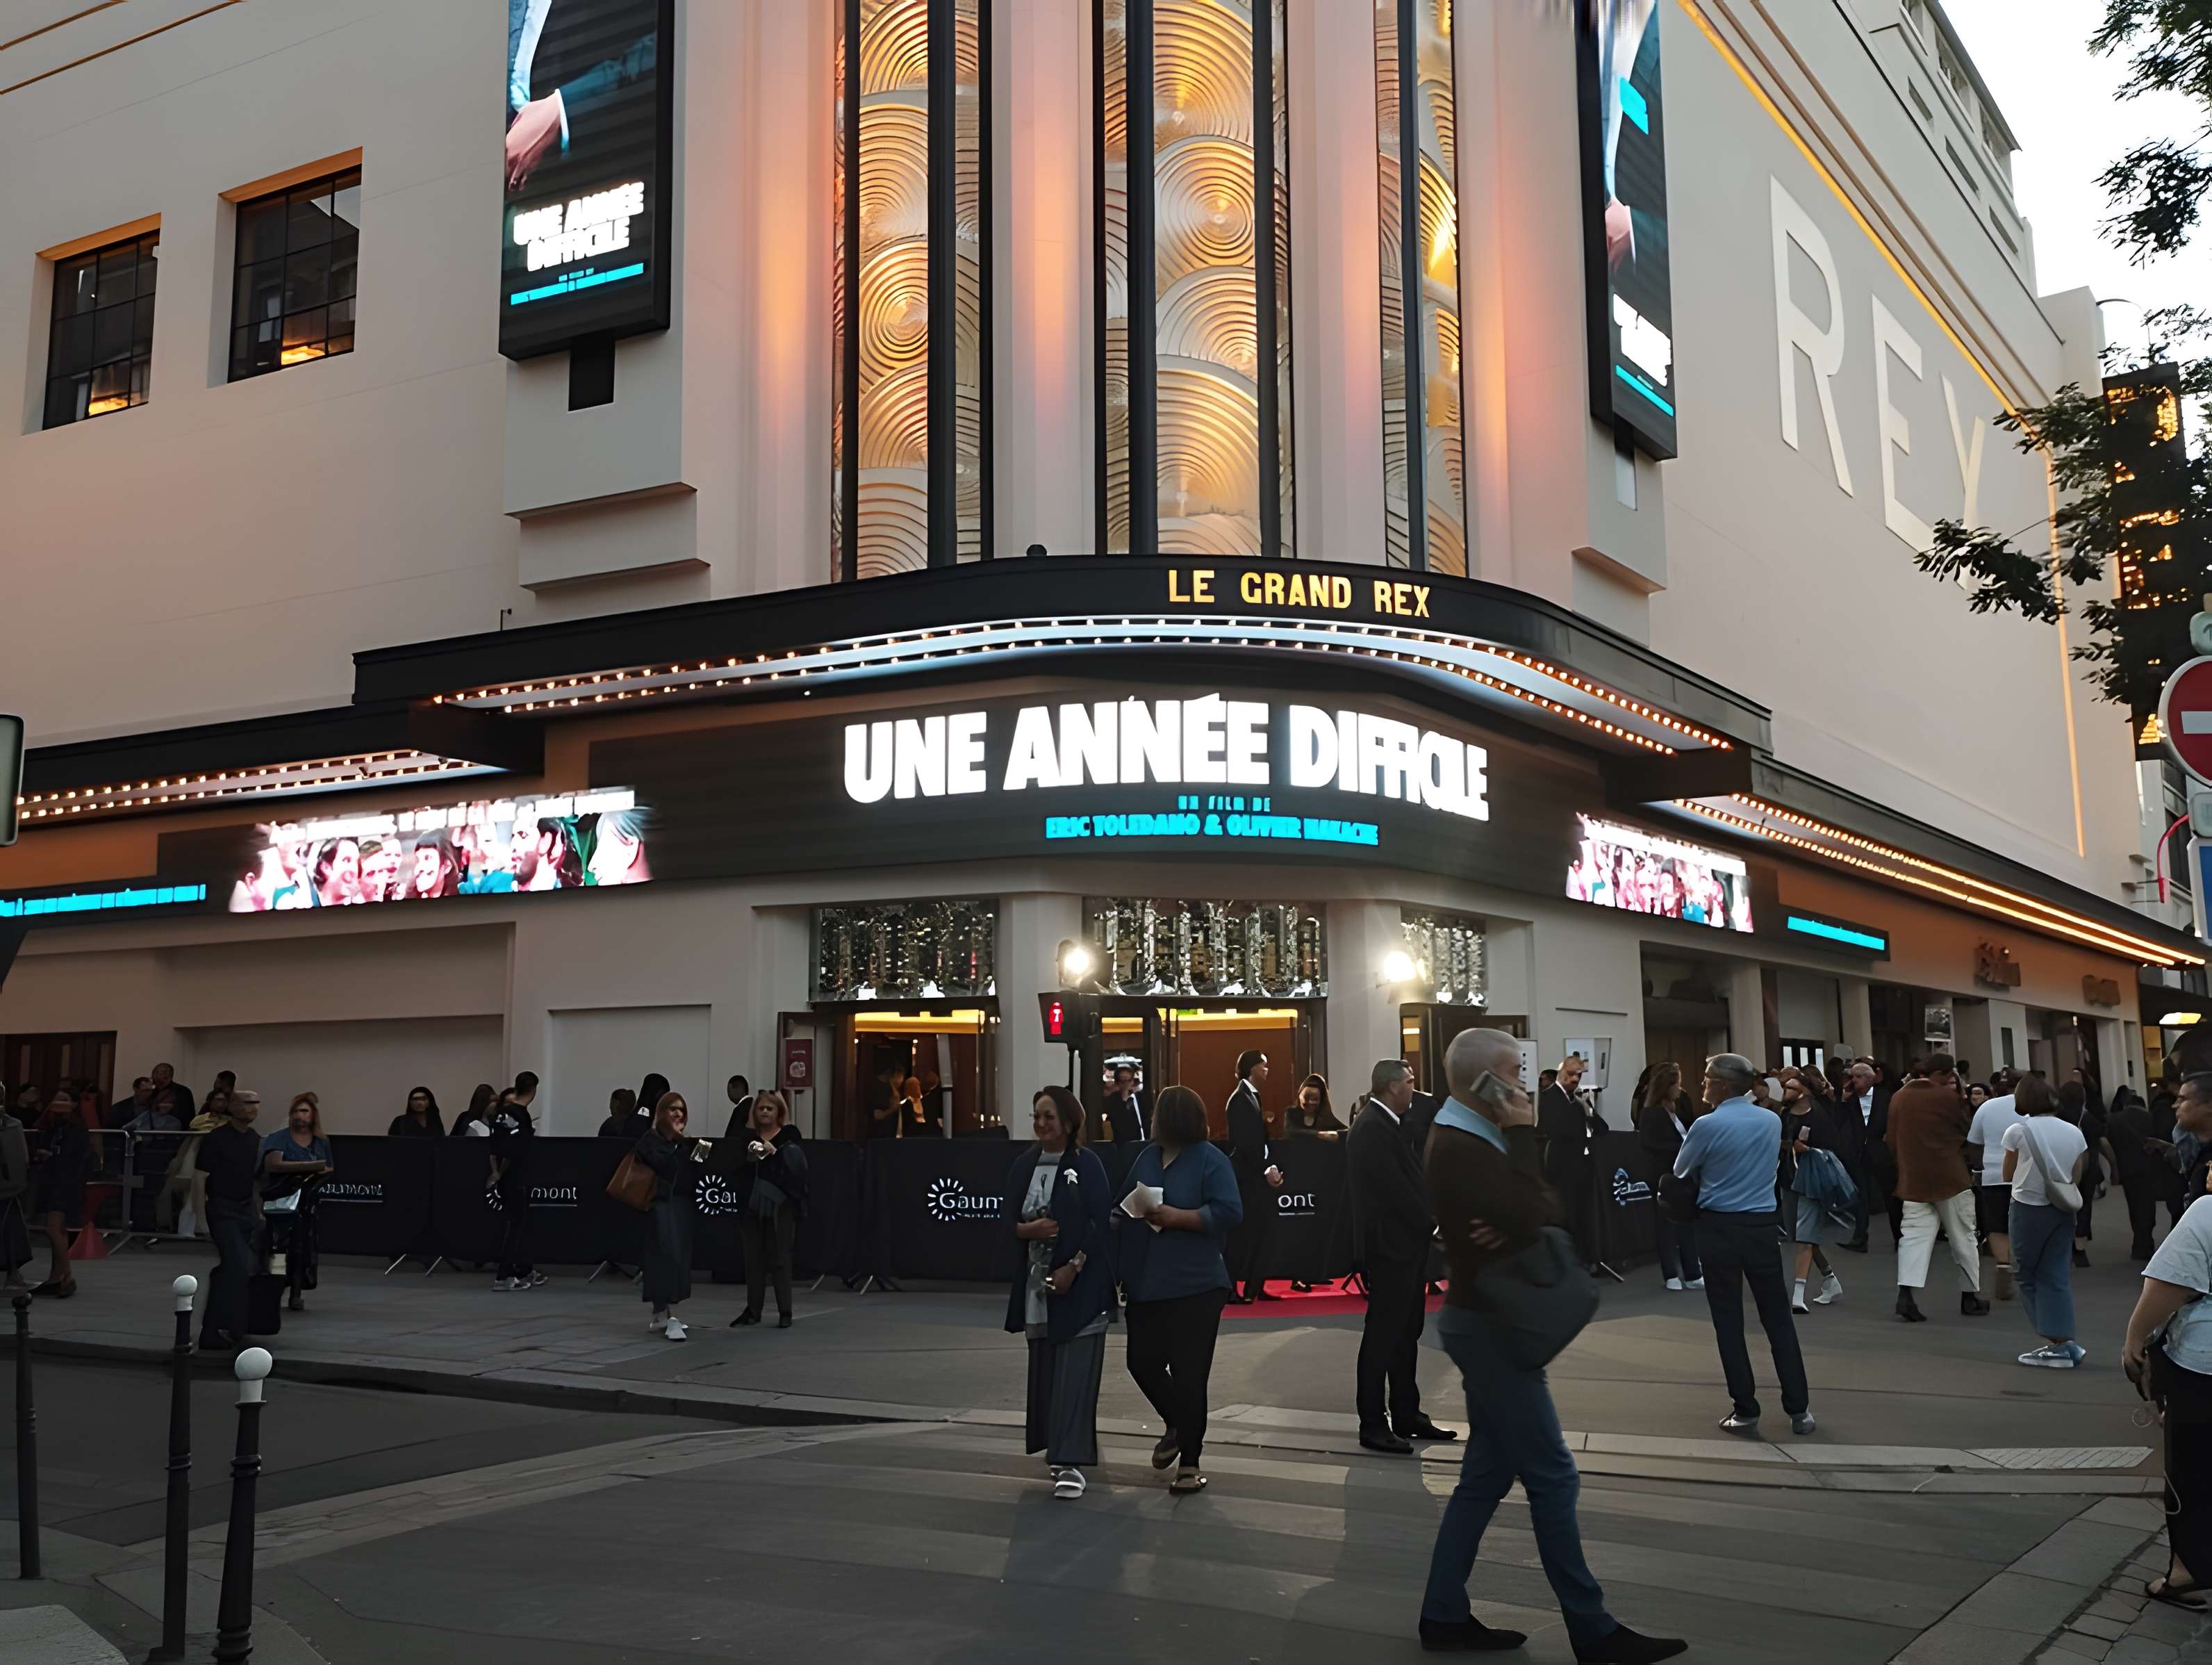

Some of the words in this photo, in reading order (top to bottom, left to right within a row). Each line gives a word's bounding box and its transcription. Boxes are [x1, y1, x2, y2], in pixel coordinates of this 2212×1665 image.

[1169, 569, 1215, 603] LE
[1240, 572, 1352, 609] GRAND
[1373, 580, 1430, 618] REX
[844, 711, 987, 803] UNE
